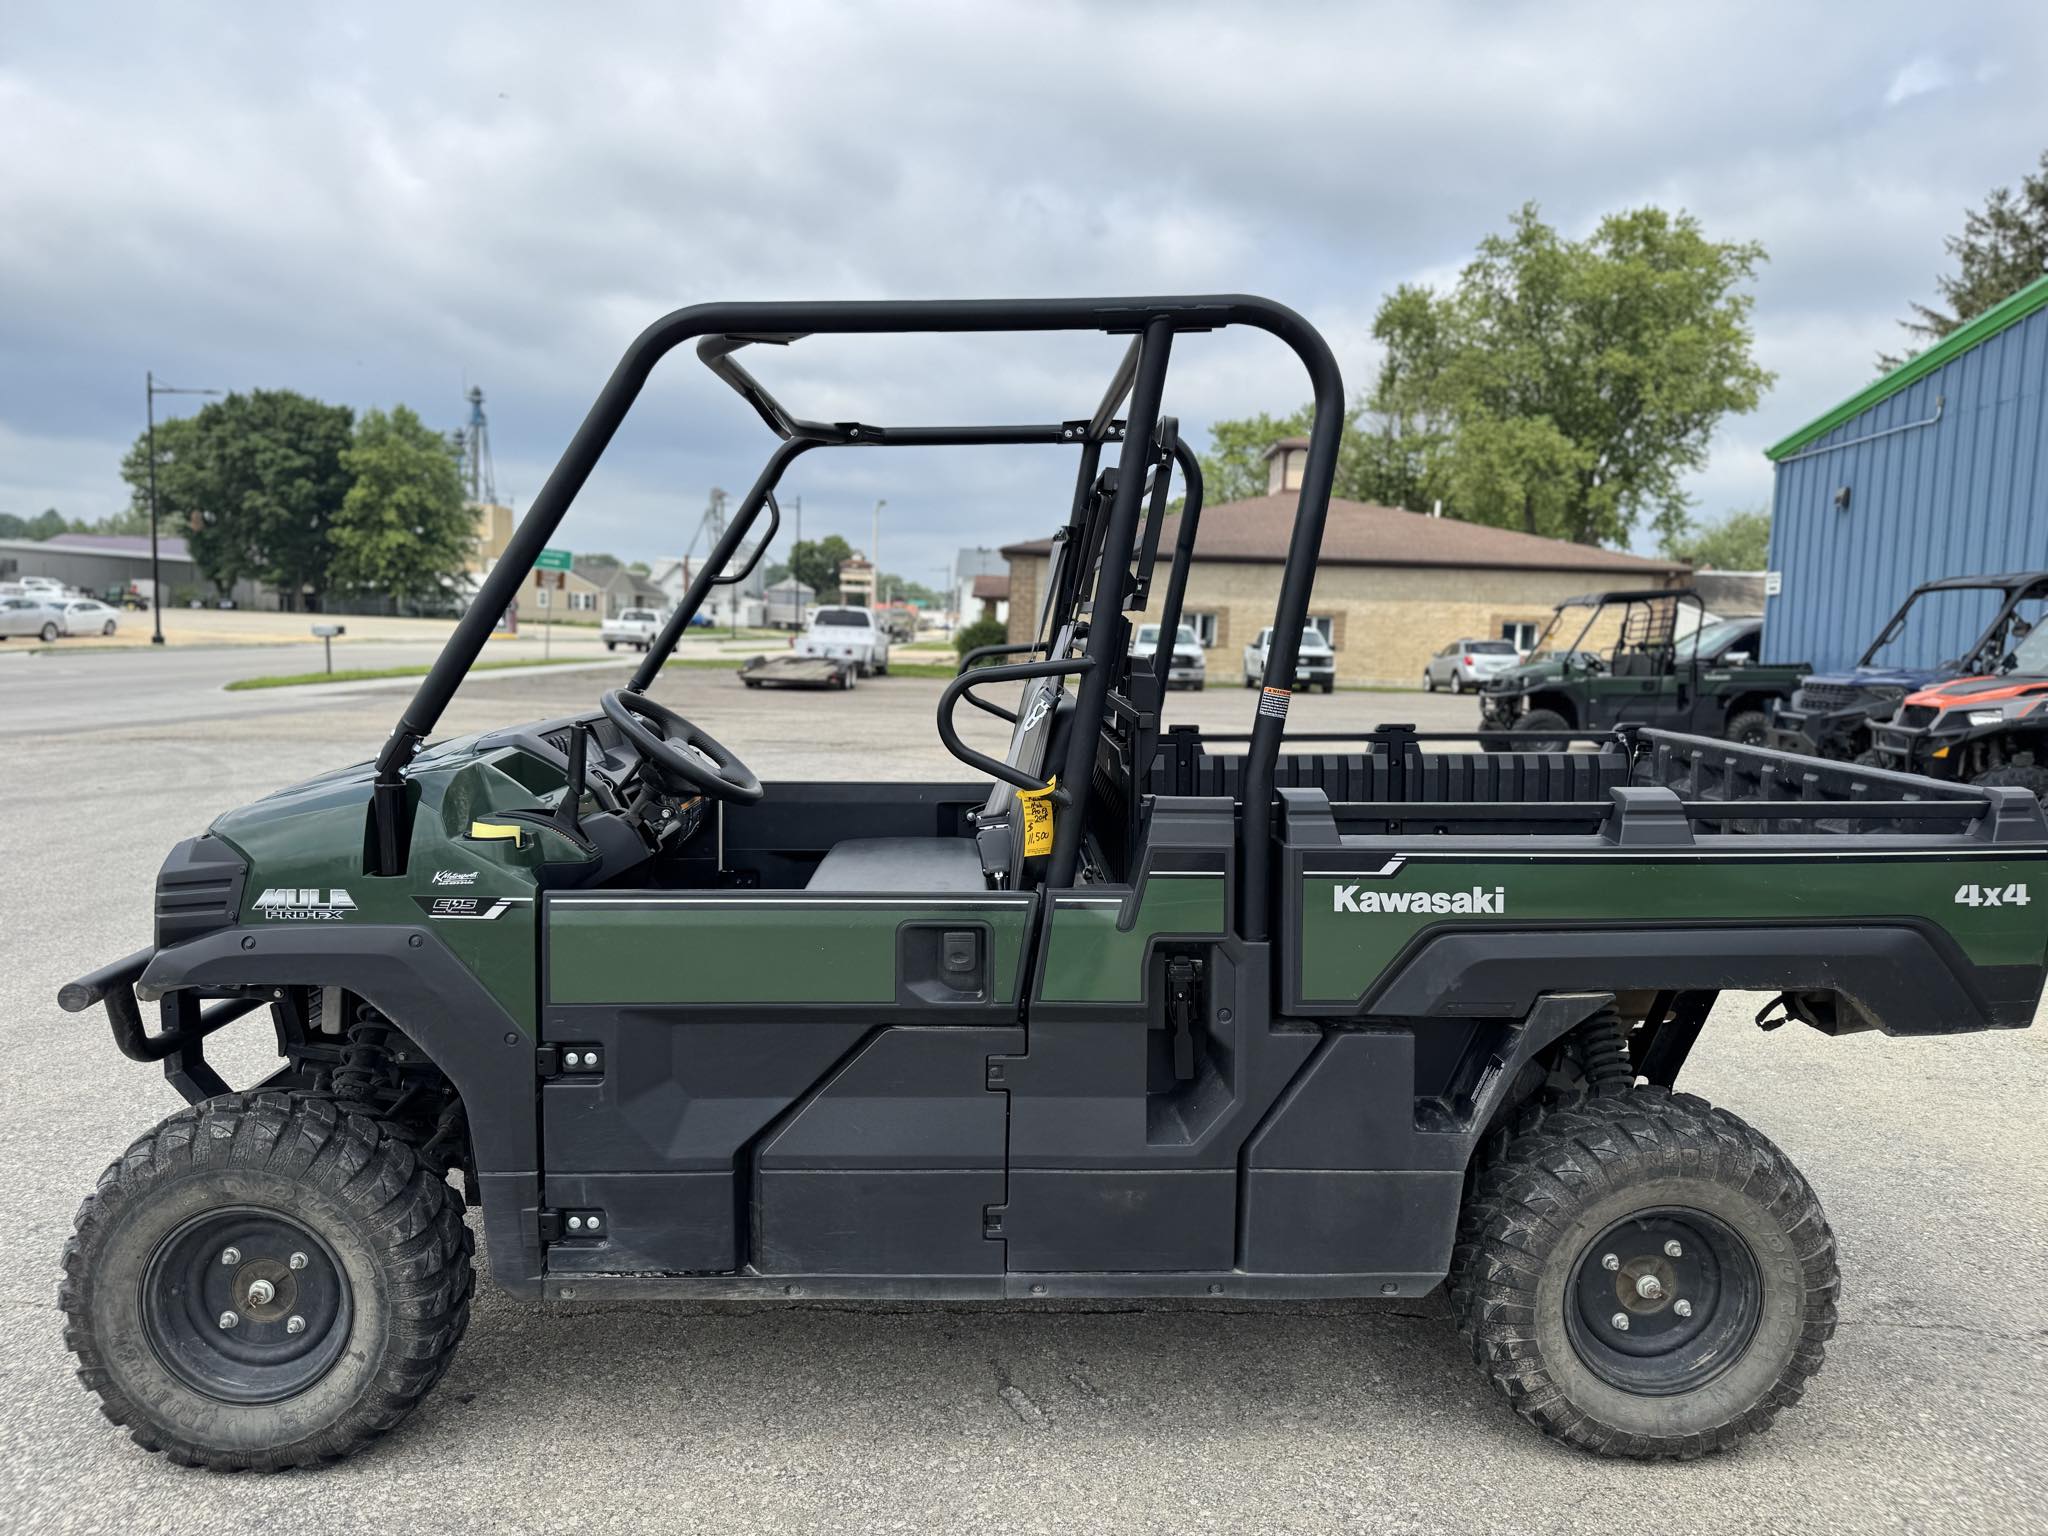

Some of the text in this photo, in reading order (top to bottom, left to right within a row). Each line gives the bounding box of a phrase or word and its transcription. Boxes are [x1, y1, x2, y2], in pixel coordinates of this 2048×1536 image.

[251, 889, 359, 910] MULE
[432, 898, 478, 911] EPS
[1333, 885, 1504, 914] Kawasaki
[1954, 883, 2031, 907] 4x4
